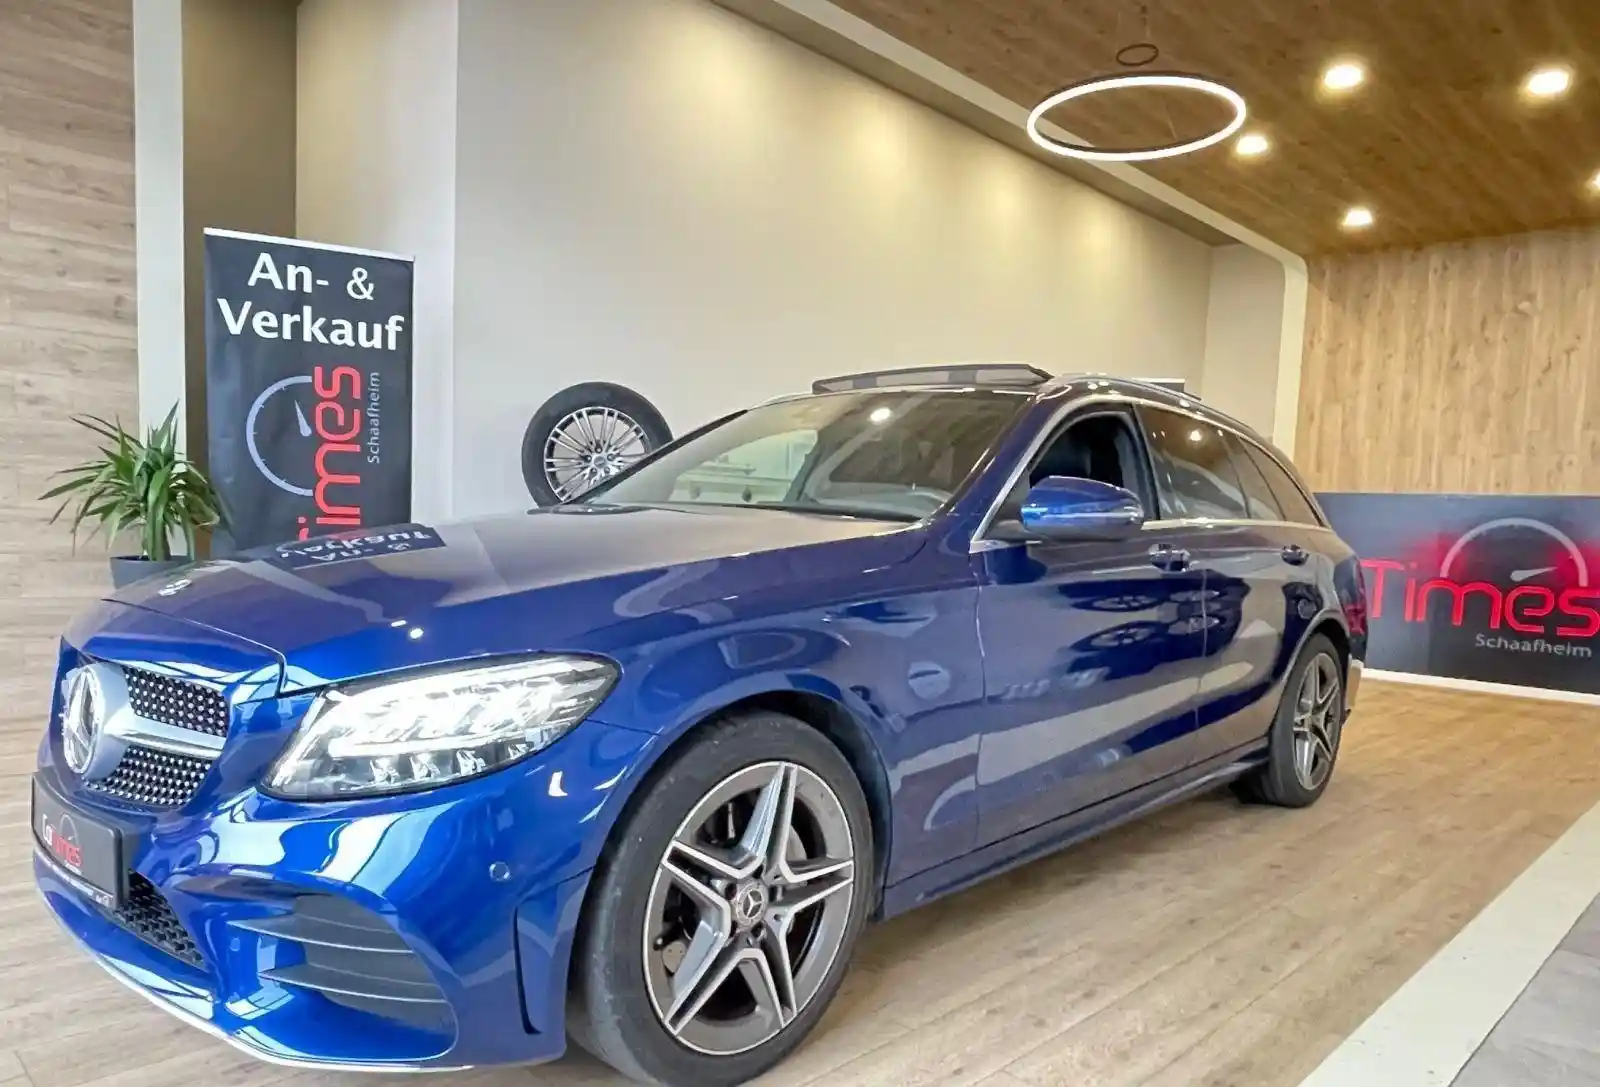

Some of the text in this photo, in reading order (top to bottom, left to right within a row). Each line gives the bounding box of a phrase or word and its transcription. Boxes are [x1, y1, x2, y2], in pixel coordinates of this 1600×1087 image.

[247, 252, 375, 301] An- &
[216, 297, 406, 351] Verkauf
[366, 371, 381, 465] Schaafheim
[297, 366, 361, 542] imes
[1359, 557, 1600, 638] Times
[1474, 632, 1593, 659] Schaafheim
